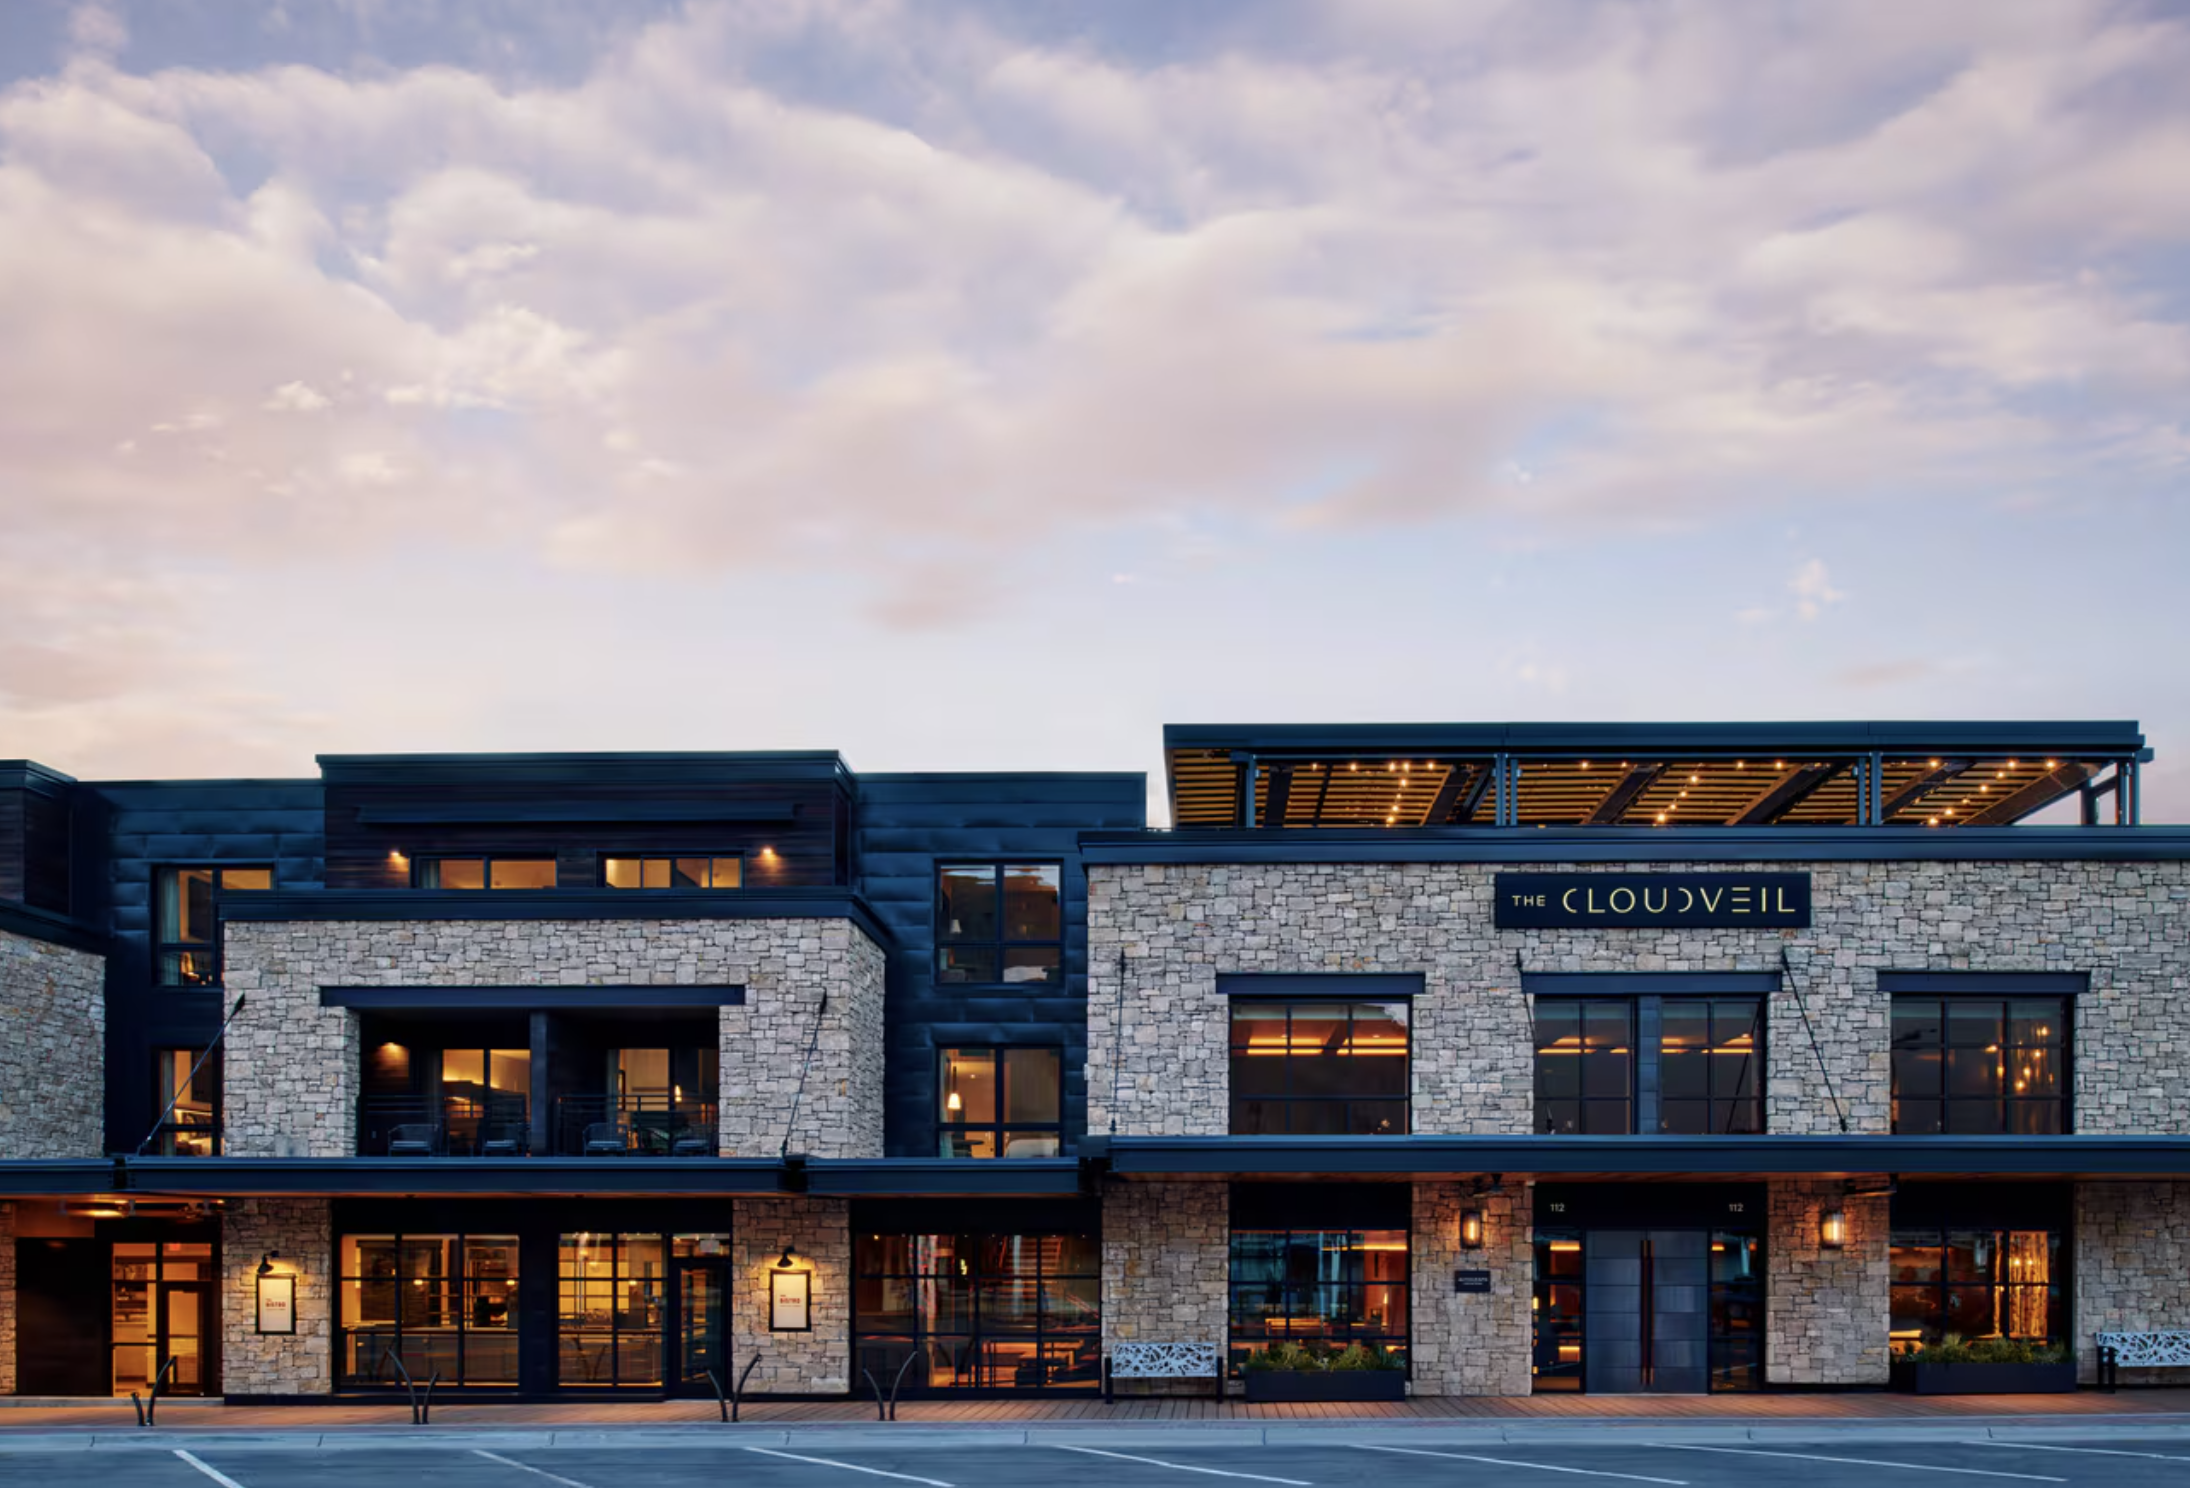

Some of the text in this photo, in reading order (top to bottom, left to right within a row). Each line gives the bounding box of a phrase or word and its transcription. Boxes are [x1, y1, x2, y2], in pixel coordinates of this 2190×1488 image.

[1512, 887, 1796, 913] THE CLOUDVEIL
[1550, 1203, 1565, 1212] 112
[1729, 1203, 1744, 1212] 112
